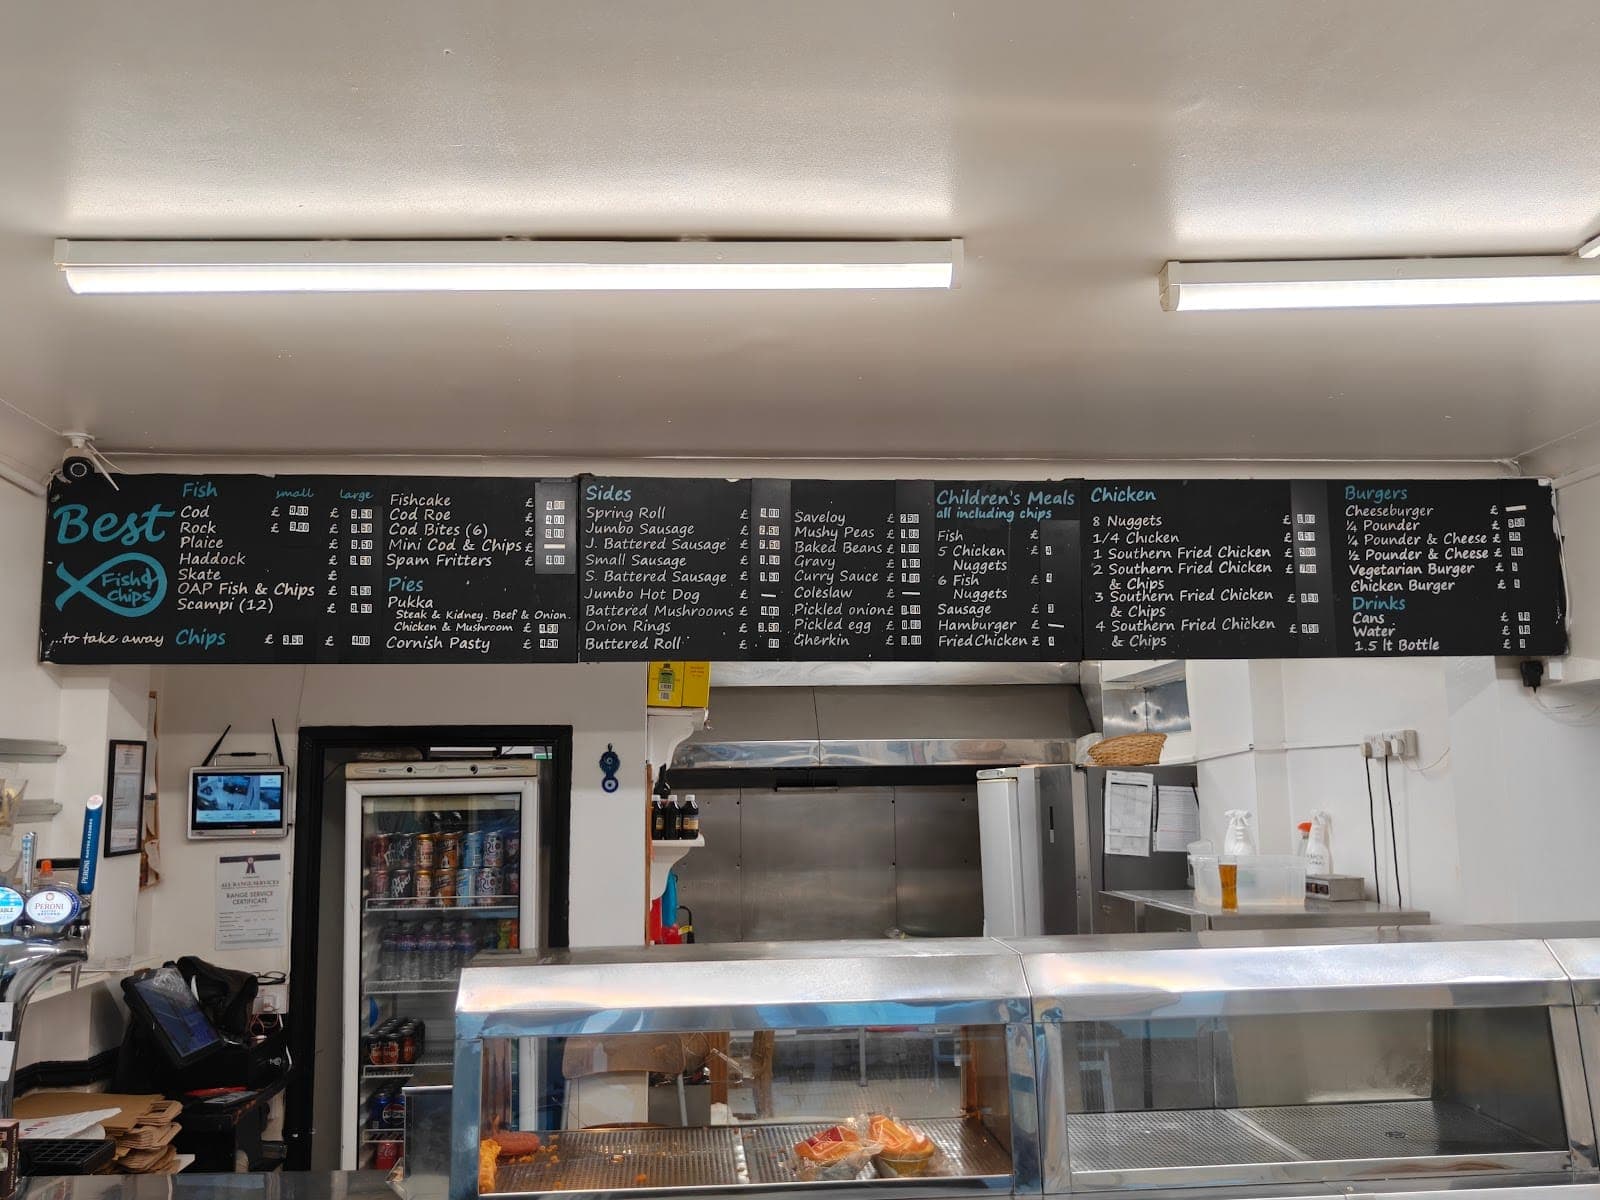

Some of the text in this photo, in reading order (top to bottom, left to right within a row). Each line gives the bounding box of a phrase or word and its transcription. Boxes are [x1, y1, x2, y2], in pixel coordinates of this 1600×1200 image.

[182, 483, 217, 497] Fish
[276, 488, 373, 500] small large
[586, 485, 631, 501] Sides
[1091, 486, 1156, 503] Chicken
[1345, 485, 1407, 504] Burgers
[391, 494, 451, 506] Fishcake
[936, 490, 1074, 506] Children's Meals
[181, 505, 210, 518] Cod
[390, 509, 451, 520] Cod Roe
[586, 506, 665, 522] Spring Roll
[936, 507, 1052, 522] all including chips
[1346, 505, 1433, 520] Cheeseburger
[53, 503, 175, 545] Best
[794, 512, 845, 526] Saveloy
[1093, 515, 1162, 531] 8 Nuggets
[1364, 520, 1420, 531] Pounder
[180, 522, 216, 534] Rock
[389, 523, 488, 539] Cod Bites (6)
[586, 522, 694, 537] Jumbo Sausage
[180, 536, 223, 549] Plaice
[795, 527, 875, 544] Mushy Peas
[937, 530, 963, 542] Fish
[1093, 532, 1179, 544] 1/4 Chicken
[1365, 533, 1487, 545] Pounder & Cheese
[389, 539, 521, 554] Mini Cod & Chips
[586, 538, 726, 554] J. Battered Sausage
[795, 541, 882, 553] Baked Beans
[937, 545, 1005, 557] 5 Chicken
[1093, 546, 1271, 559] 1 Southern Fried Chicken
[180, 553, 245, 565] Haddock
[386, 554, 492, 569] Spam Fritters
[586, 554, 686, 569] Small Sausage
[1366, 548, 1488, 561] Pounder & Cheese
[795, 556, 835, 571] Gravy
[953, 560, 1007, 574] Nuggets
[1093, 560, 1272, 575] 2 Southern Fried Chicken
[178, 568, 221, 580] Skate
[586, 570, 727, 586] S. Battered Sausage
[794, 571, 879, 585] Curry Sauce
[1350, 563, 1474, 579] Vegetarian Burger
[389, 577, 423, 591] Pies
[938, 575, 980, 586] 6 Fish
[1109, 577, 1164, 594] & Chips
[1351, 580, 1455, 594] Chicken Burger
[178, 583, 315, 597] OAP Fish & Chips
[584, 587, 700, 604] Jumbo Hot Dog
[794, 587, 852, 598] Coleslaw
[953, 588, 1007, 602] Nuggets
[1095, 588, 1273, 602] 3 Southern Fried Chicken
[107, 588, 152, 607] Chips
[388, 596, 433, 608] Pukka
[1353, 596, 1405, 610] Drinks
[177, 599, 273, 613] Scampi (12)
[586, 604, 734, 616] Battered Mushrooms
[794, 604, 886, 615] Pickled onion
[937, 604, 991, 618] Sausage
[1110, 604, 1166, 620] & Chips
[396, 610, 427, 618] Steak
[493, 610, 517, 619] Beef
[521, 611, 529, 619] &
[1353, 613, 1384, 624] Cans
[394, 622, 513, 632] Chicken & Mushroom
[586, 620, 671, 635] Onion Rings
[794, 619, 871, 634] Pickled egg
[939, 619, 1017, 634] Hamburger
[1096, 617, 1275, 633] 4 Southern Fried Chicken
[1353, 627, 1395, 637] Water
[83, 632, 118, 643] take
[122, 635, 164, 647] away
[176, 629, 226, 646] Chips
[387, 636, 490, 653] Cornish Pasty
[586, 636, 681, 650] Buttered Roll
[794, 634, 850, 646] Gherkin
[1112, 634, 1167, 650] & Chips
[1355, 641, 1377, 651] 1.5
[1399, 637, 1439, 651] Bottle
[82, 860, 90, 884] PERONI
[35, 902, 64, 910] PERONI
